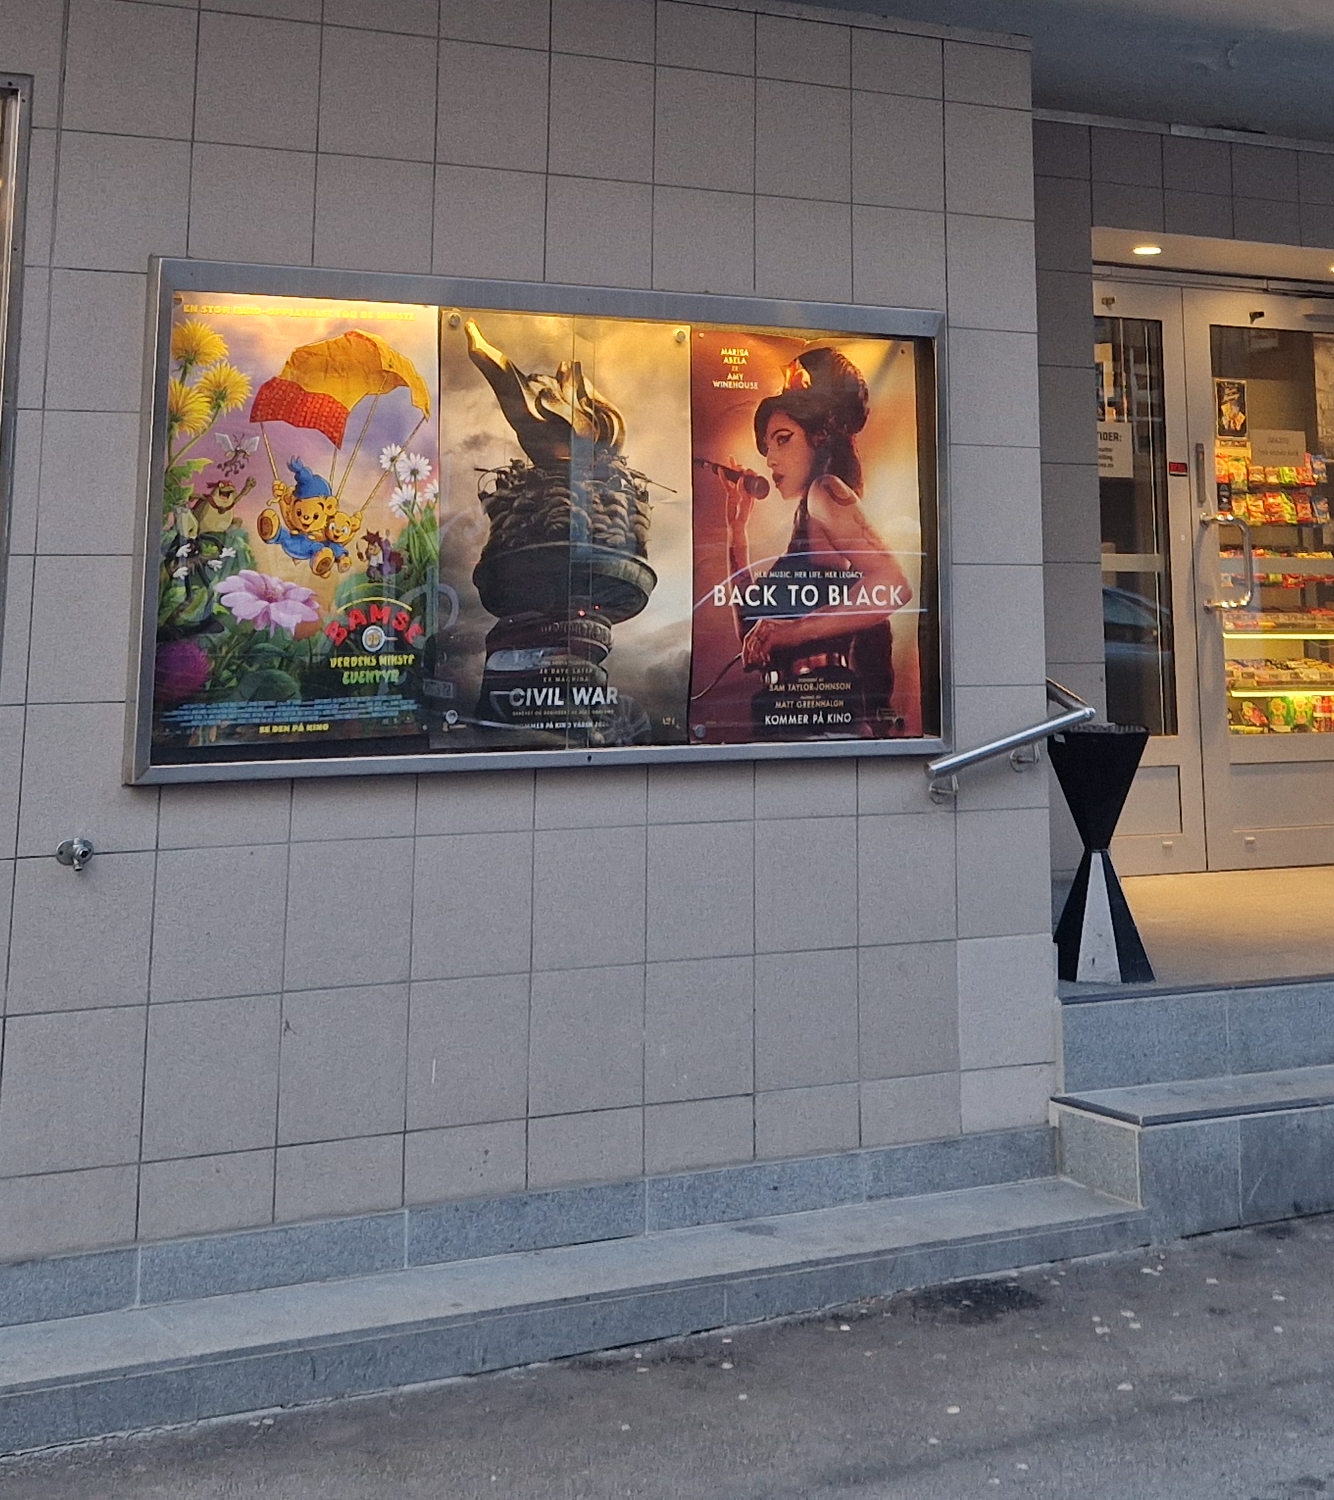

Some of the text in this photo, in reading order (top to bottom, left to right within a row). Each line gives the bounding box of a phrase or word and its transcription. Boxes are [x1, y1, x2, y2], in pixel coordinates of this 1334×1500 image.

[721, 348, 749, 356] MARISA
[712, 380, 759, 390] WINEHOUSE
[794, 571, 807, 579] HER
[824, 571, 838, 579] HER
[713, 584, 904, 607] BACK TO BLACK
[330, 655, 377, 668] VERDENS
[769, 684, 785, 692] SAM
[509, 686, 618, 707] CIVIL WAR
[765, 711, 852, 726] KOMMER PÅ KINO
[271, 724, 290, 734] DEN
[292, 722, 304, 733] PÅ
[306, 723, 329, 732] KINO
